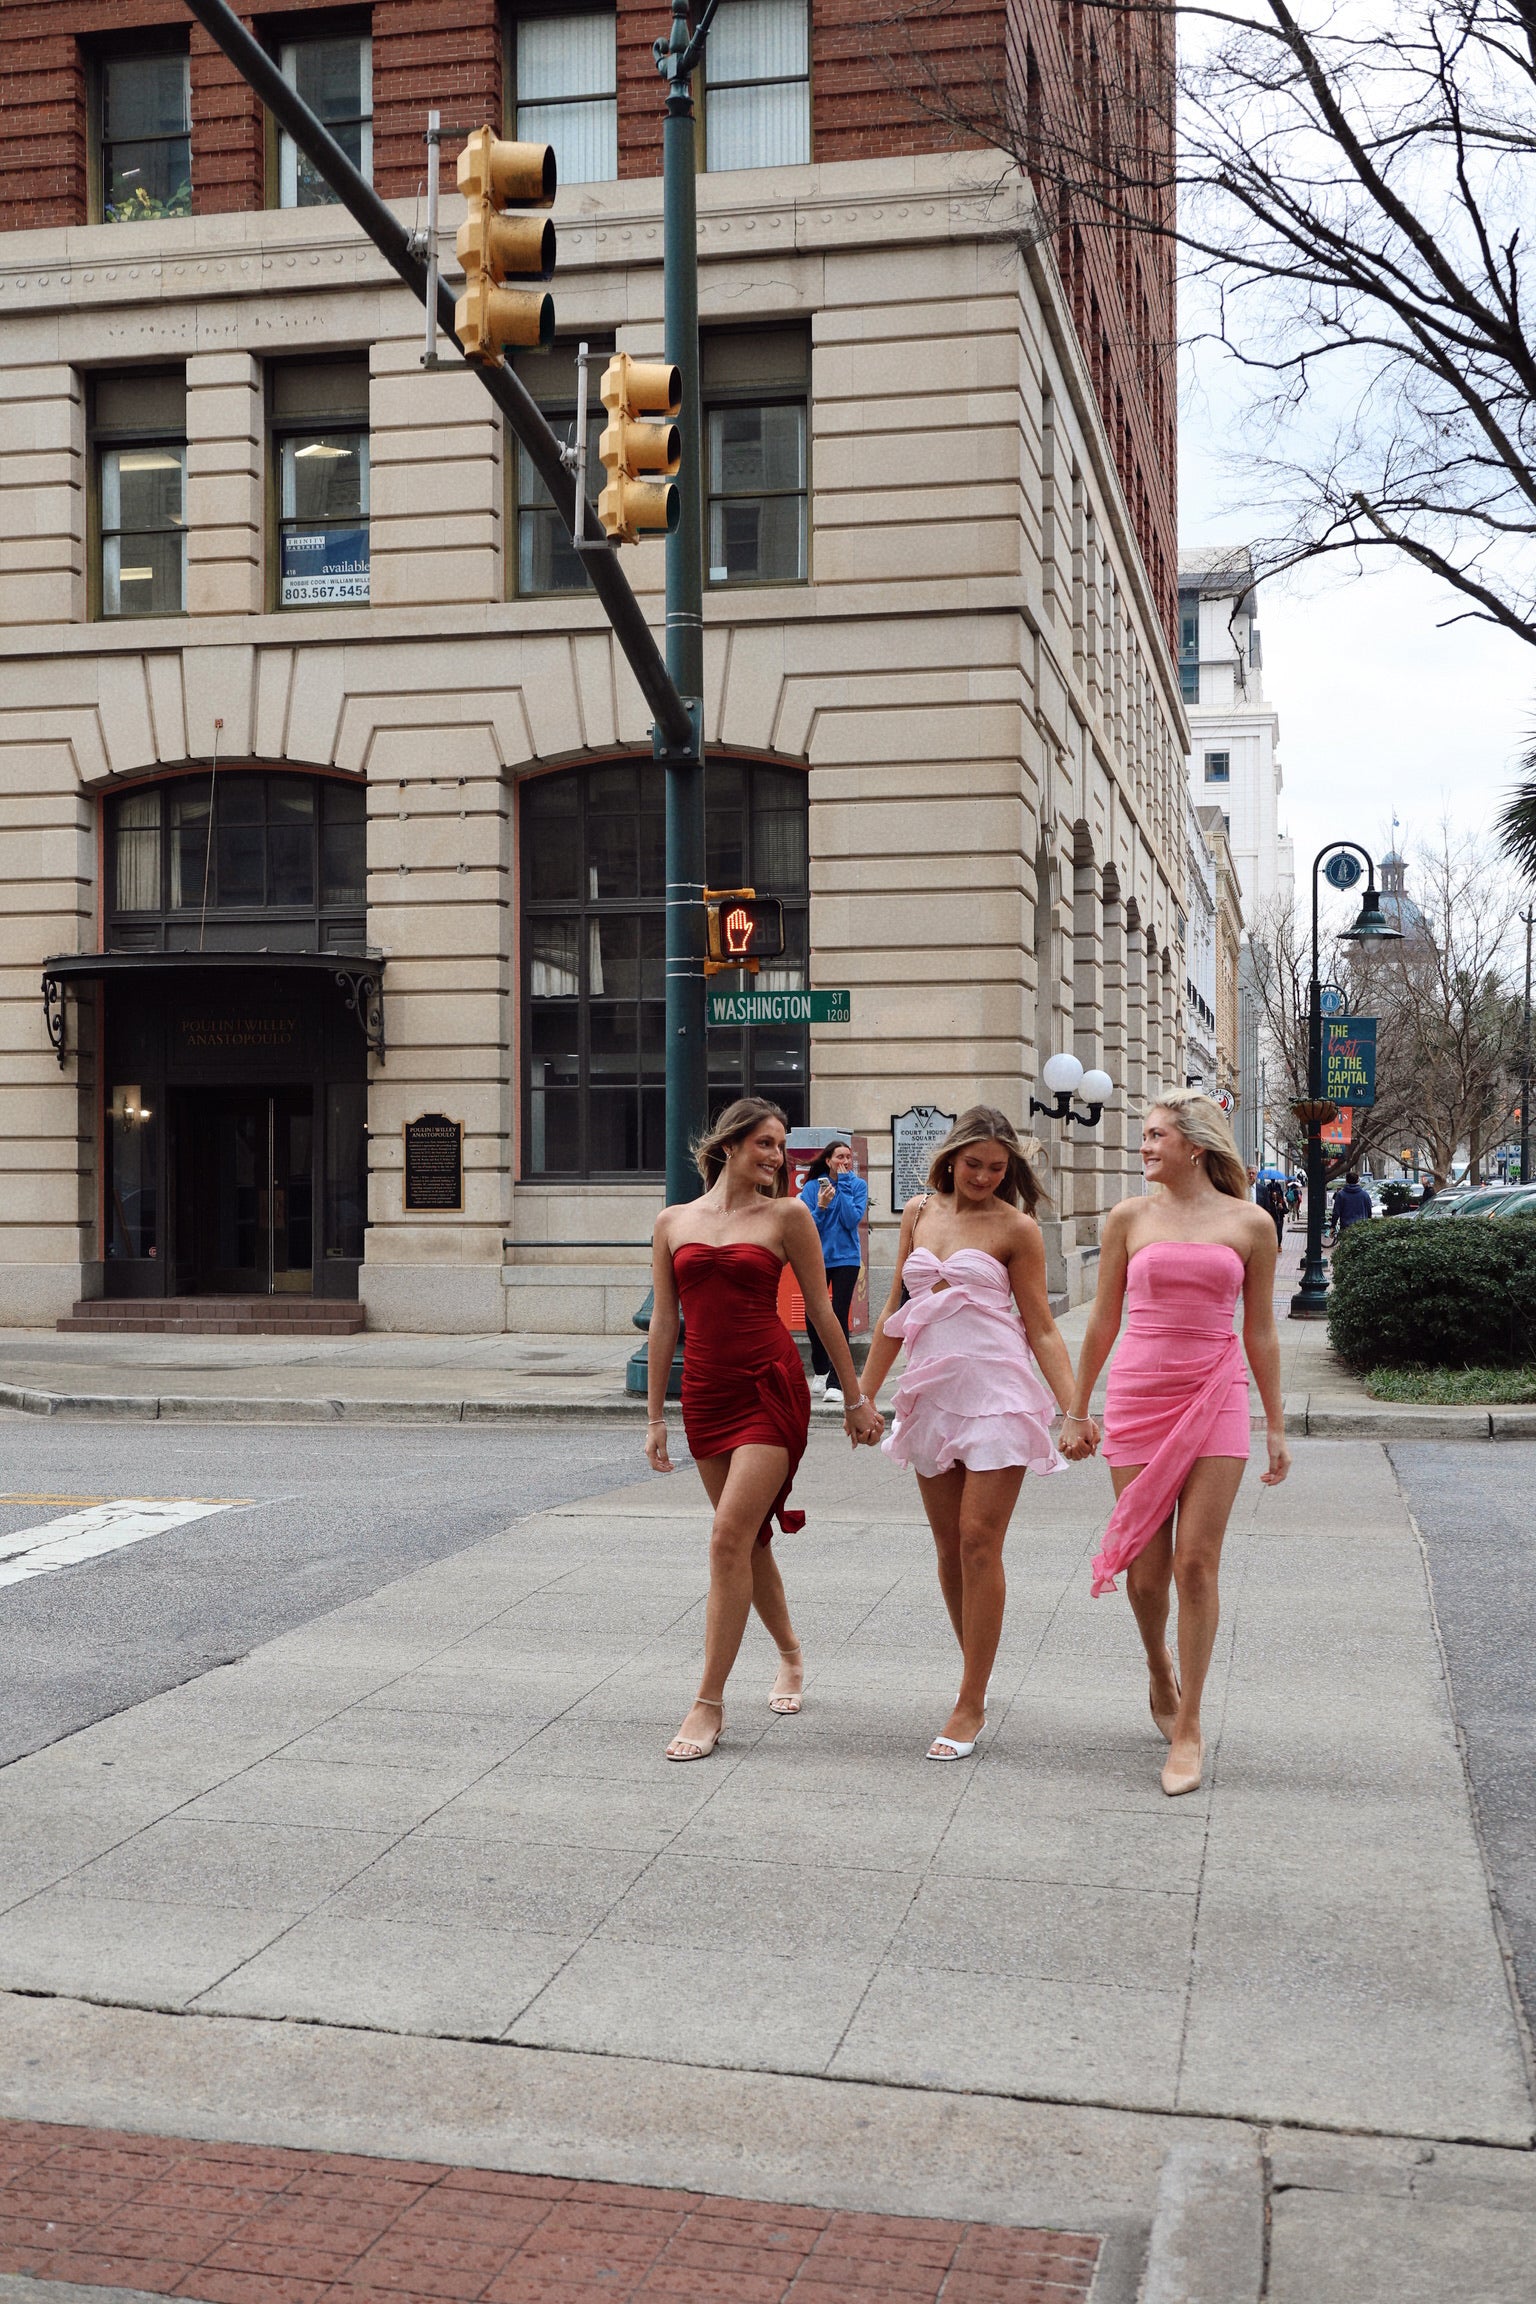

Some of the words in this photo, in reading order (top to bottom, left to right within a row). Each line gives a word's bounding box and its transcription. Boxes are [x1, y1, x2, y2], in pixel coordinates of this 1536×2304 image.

[322, 560, 370, 573] available
[285, 585, 370, 599] 803.567.5454
[831, 993, 843, 1005] ST
[713, 996, 811, 1020] WASHINGTON
[827, 1009, 849, 1021] 1200
[1329, 1024, 1348, 1038] THE
[1328, 1035, 1374, 1059] heart
[1328, 1056, 1341, 1069] OF
[1343, 1056, 1362, 1069] THE
[1327, 1071, 1368, 1084] CAPITAL
[1327, 1085, 1350, 1098] CITY
